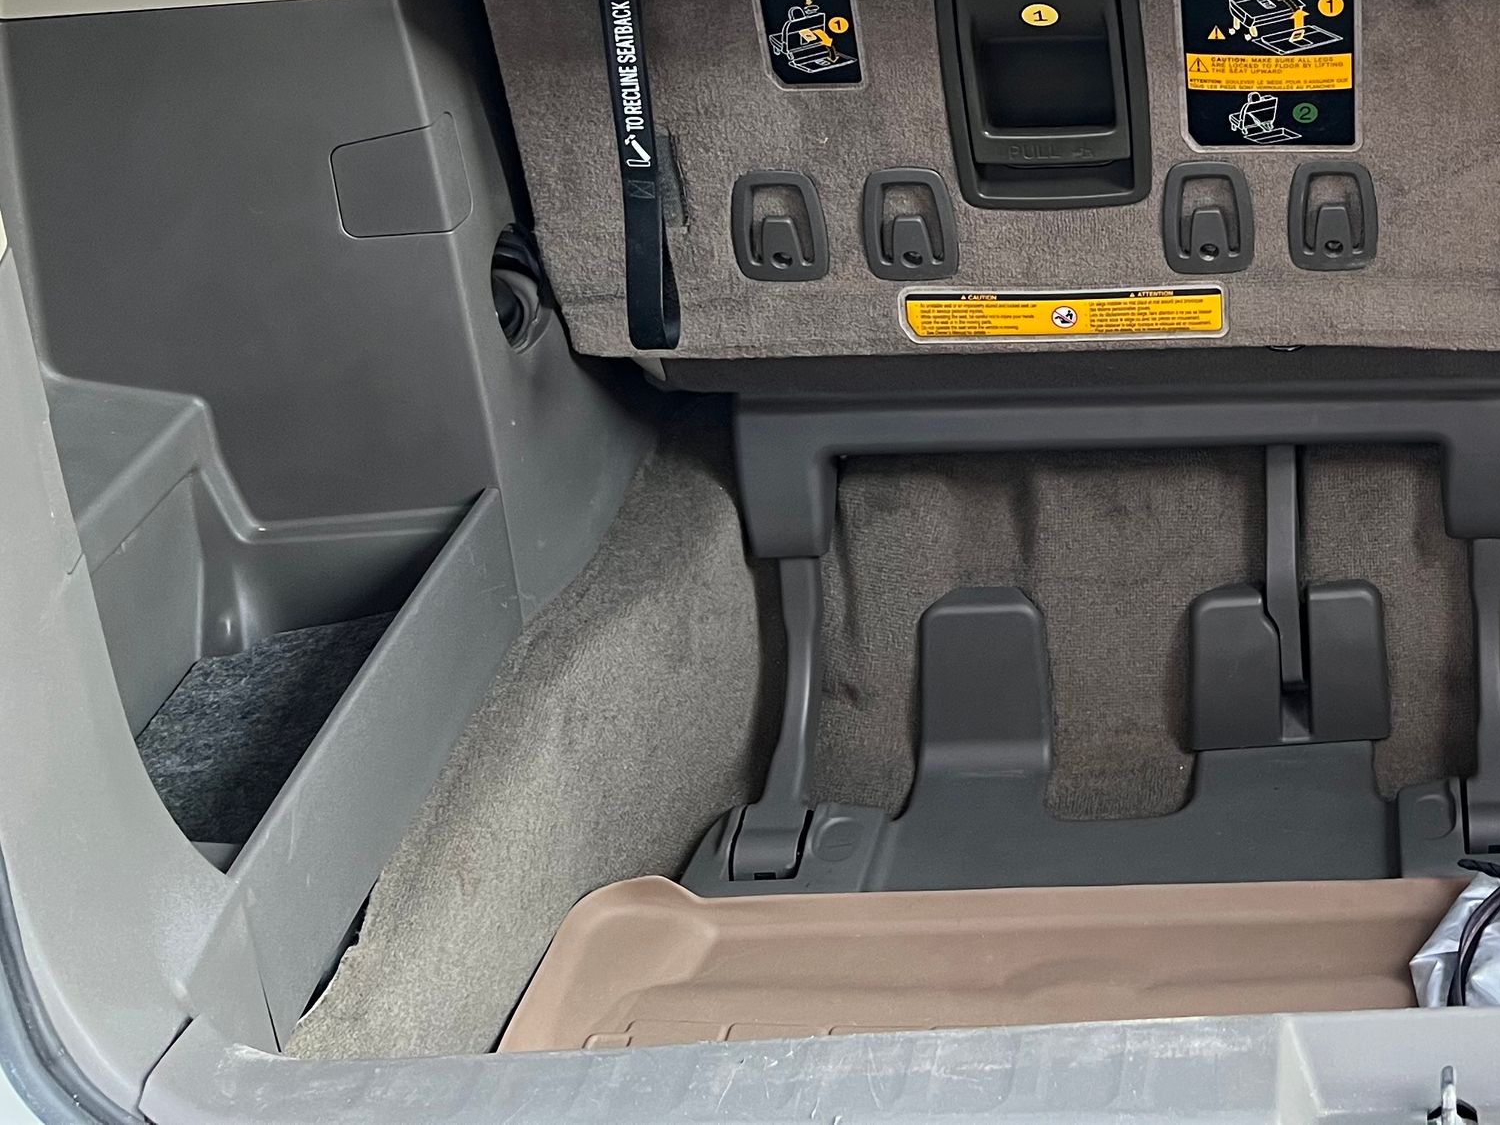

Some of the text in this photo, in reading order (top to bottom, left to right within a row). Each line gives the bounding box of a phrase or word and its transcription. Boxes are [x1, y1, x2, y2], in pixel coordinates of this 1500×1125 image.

[1032, 10, 1049, 22] 1
[834, 20, 841, 31] 1
[611, 0, 645, 132] TO RECLINE SEATBACK
[1300, 106, 1312, 120] 2
[1008, 145, 1062, 160] PULL
